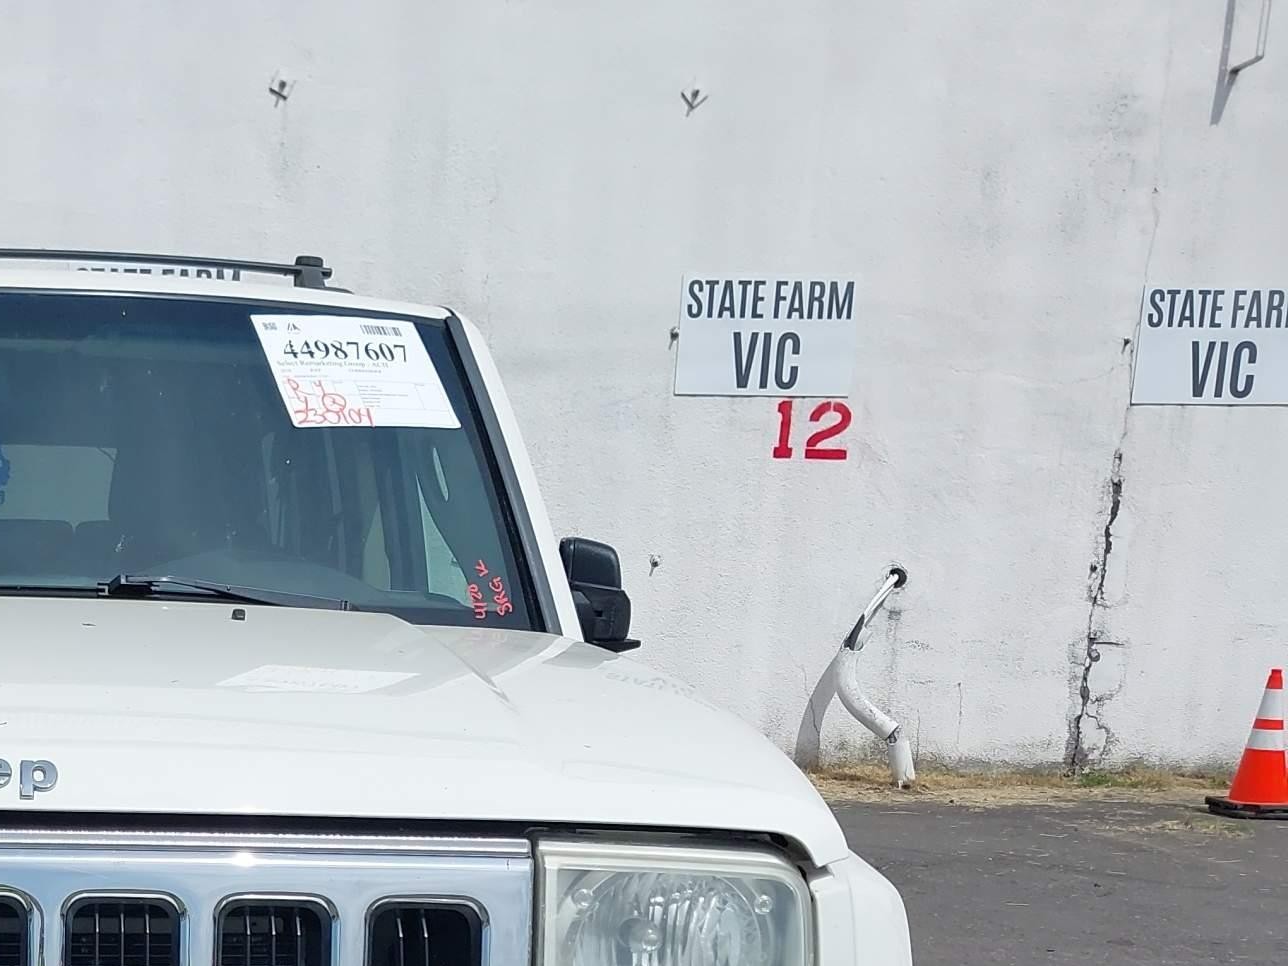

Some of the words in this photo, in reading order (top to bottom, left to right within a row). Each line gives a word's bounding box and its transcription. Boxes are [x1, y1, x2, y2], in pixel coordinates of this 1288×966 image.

[687, 280, 766, 318] STATE
[773, 281, 855, 320] FARM
[1148, 289, 1225, 328] STATE
[1230, 290, 1288, 328] FAR
[283, 339, 407, 362] 44987607
[733, 332, 801, 390] VIC
[1192, 341, 1258, 399] VIC
[773, 400, 852, 460] 12
